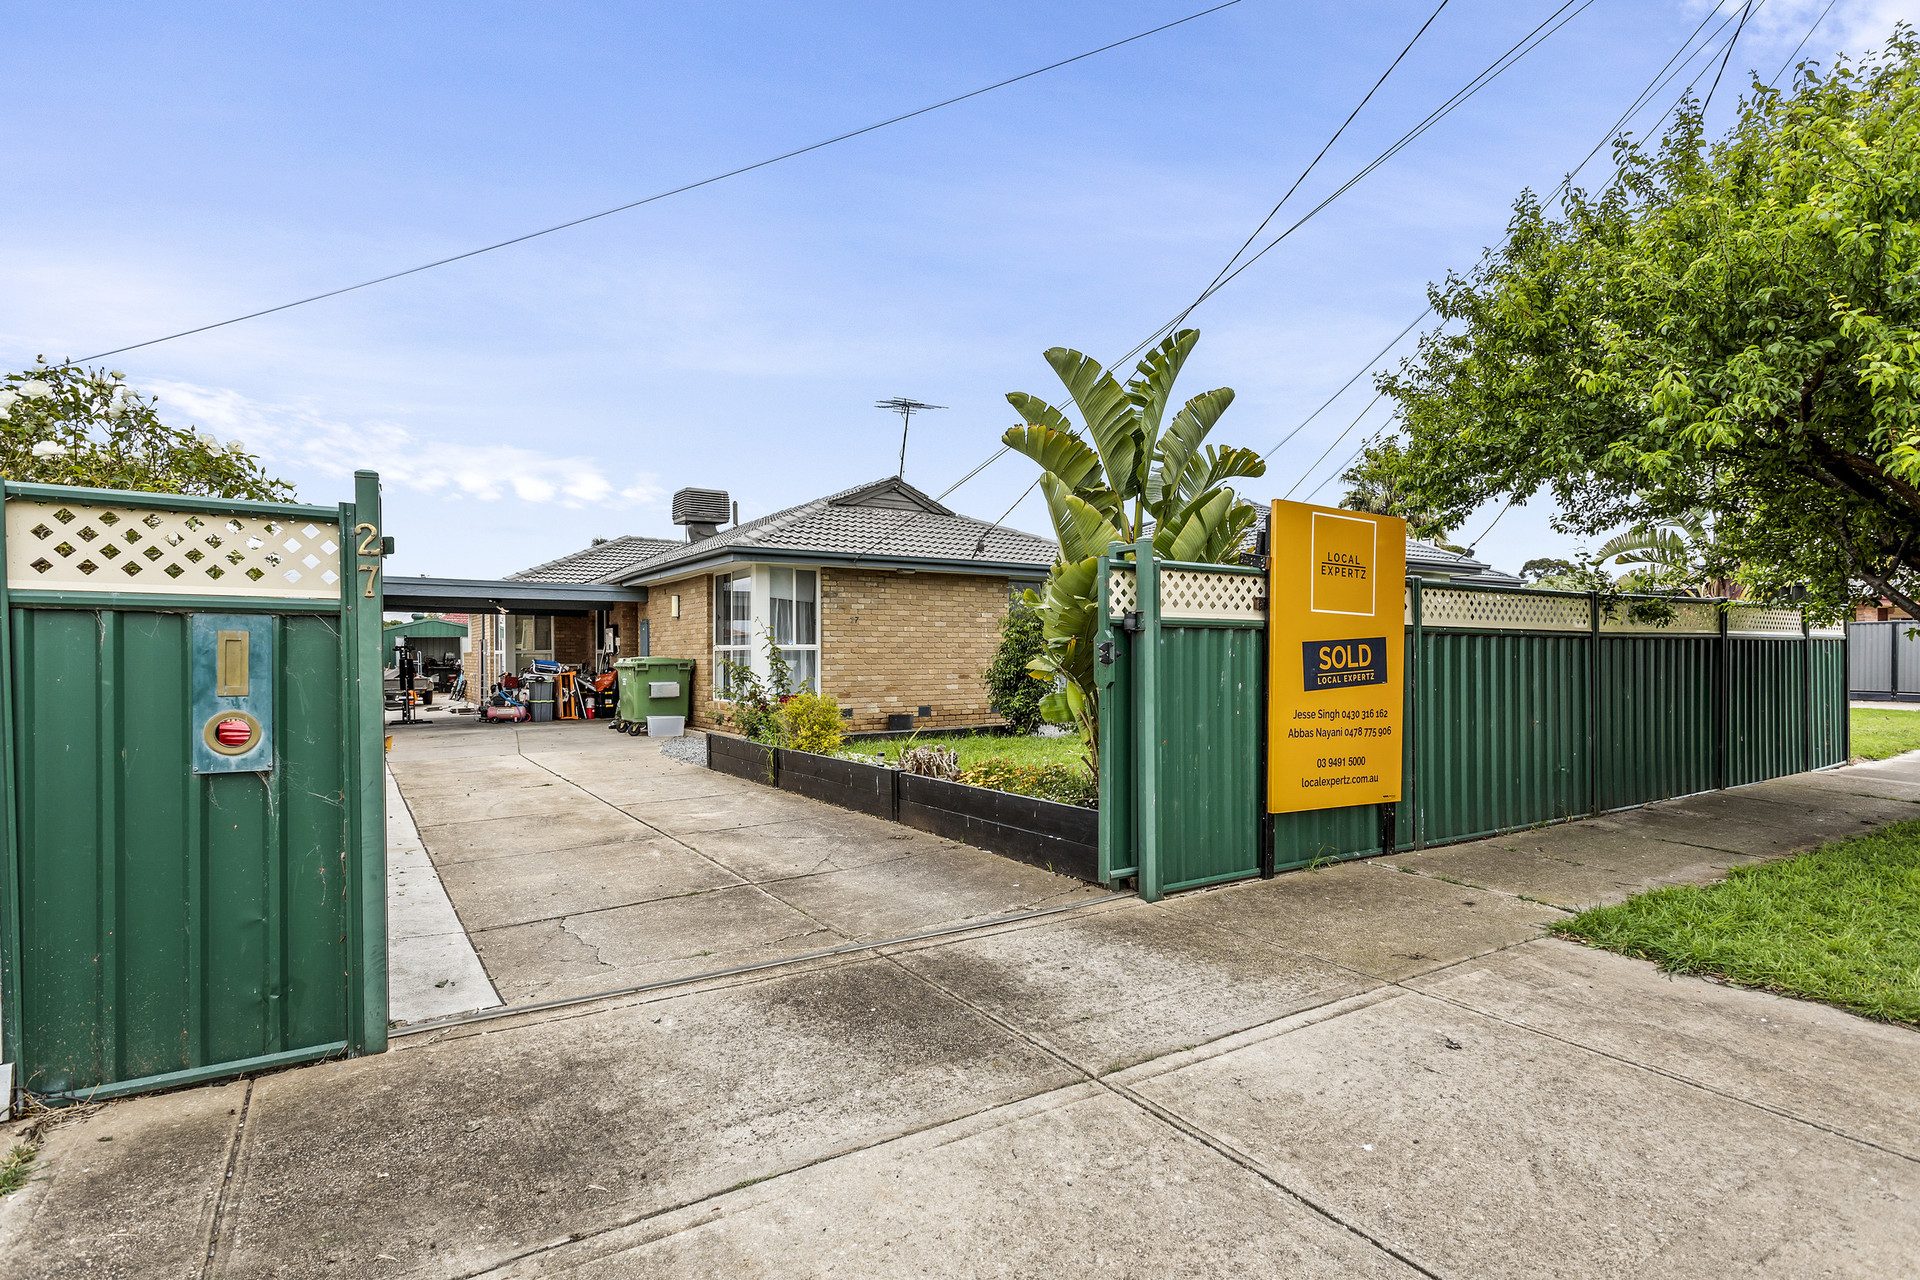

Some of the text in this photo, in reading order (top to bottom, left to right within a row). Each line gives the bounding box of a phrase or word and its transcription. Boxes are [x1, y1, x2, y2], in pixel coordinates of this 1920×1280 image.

[355, 523, 381, 598] 27
[1327, 552, 1361, 564] LOCAL
[1321, 565, 1366, 579] EXPERTZ
[1319, 644, 1372, 671] SOLD
[1317, 673, 1375, 685] LOCAL EXPERTZ
[1293, 709, 1388, 721] Jesse Singh 0430 316 162
[1288, 726, 1392, 739] Abbas Nayani 0478 775 906
[1316, 756, 1366, 768] 03 9491 5000
[1301, 775, 1379, 788] localexpertz.com.au
